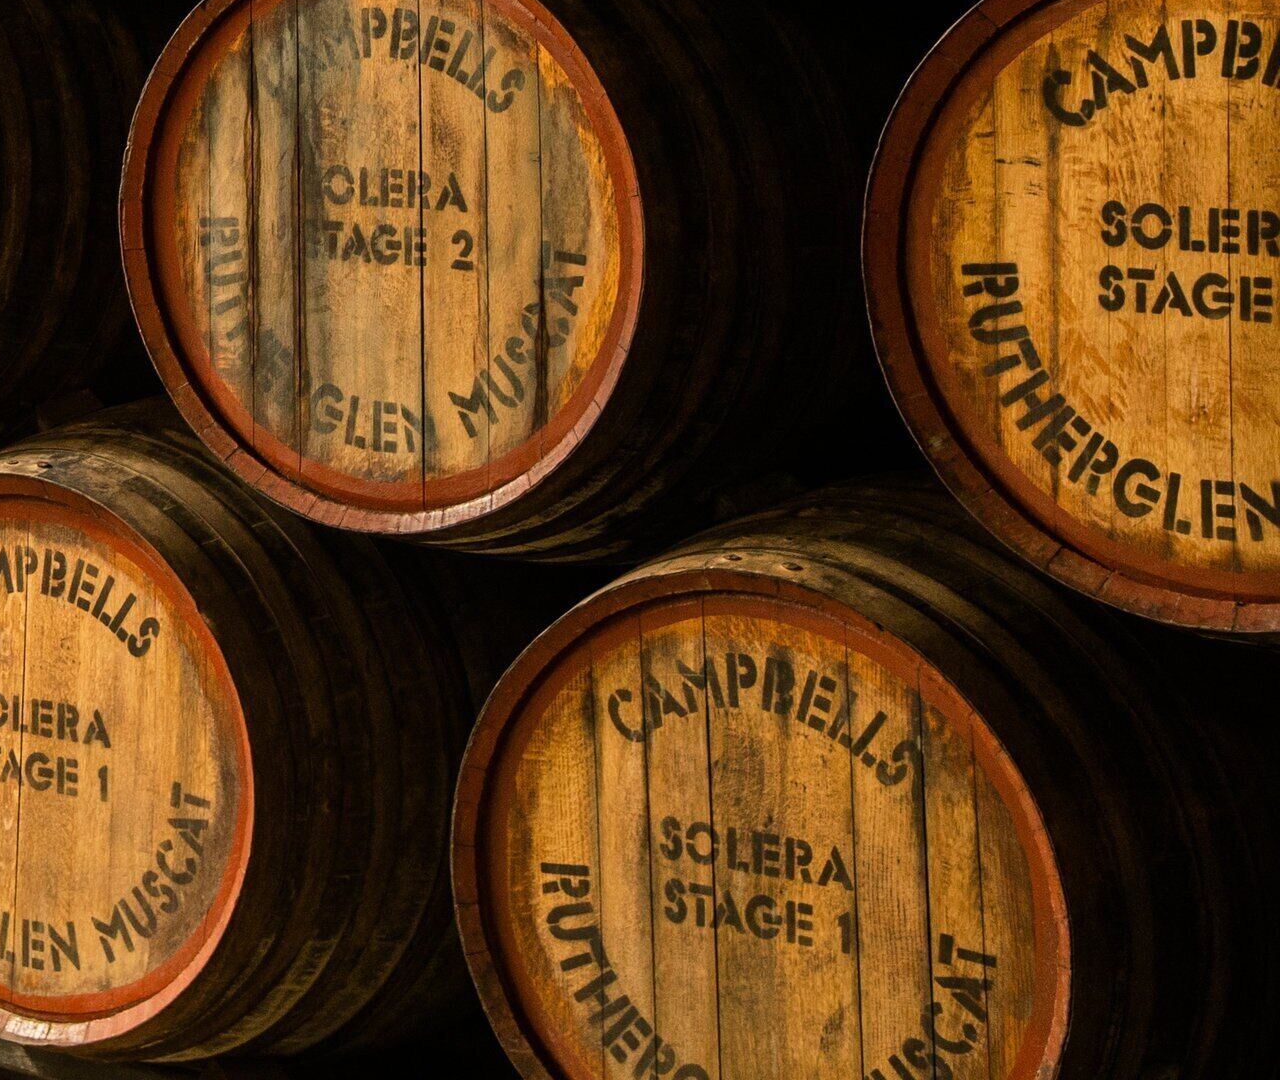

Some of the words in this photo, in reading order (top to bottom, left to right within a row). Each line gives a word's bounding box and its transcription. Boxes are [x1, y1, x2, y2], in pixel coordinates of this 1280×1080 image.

[262, 7, 526, 113] MPBELLS
[308, 164, 467, 213] OLERA
[451, 229, 474, 271] 2
[1099, 265, 1272, 323] STAGE
[200, 217, 439, 454] RUTGLEN
[448, 240, 587, 438] MUSCAT
[962, 262, 1280, 542] RUTHERGLEN
[608, 652, 922, 787] CAMPBELLS
[97, 766, 108, 802] 1
[91, 782, 211, 964] MUSCAT
[660, 816, 853, 891] SOLERA
[664, 879, 814, 948] STAGE
[838, 912, 851, 954] 1
[863, 933, 997, 1080] SCAT
